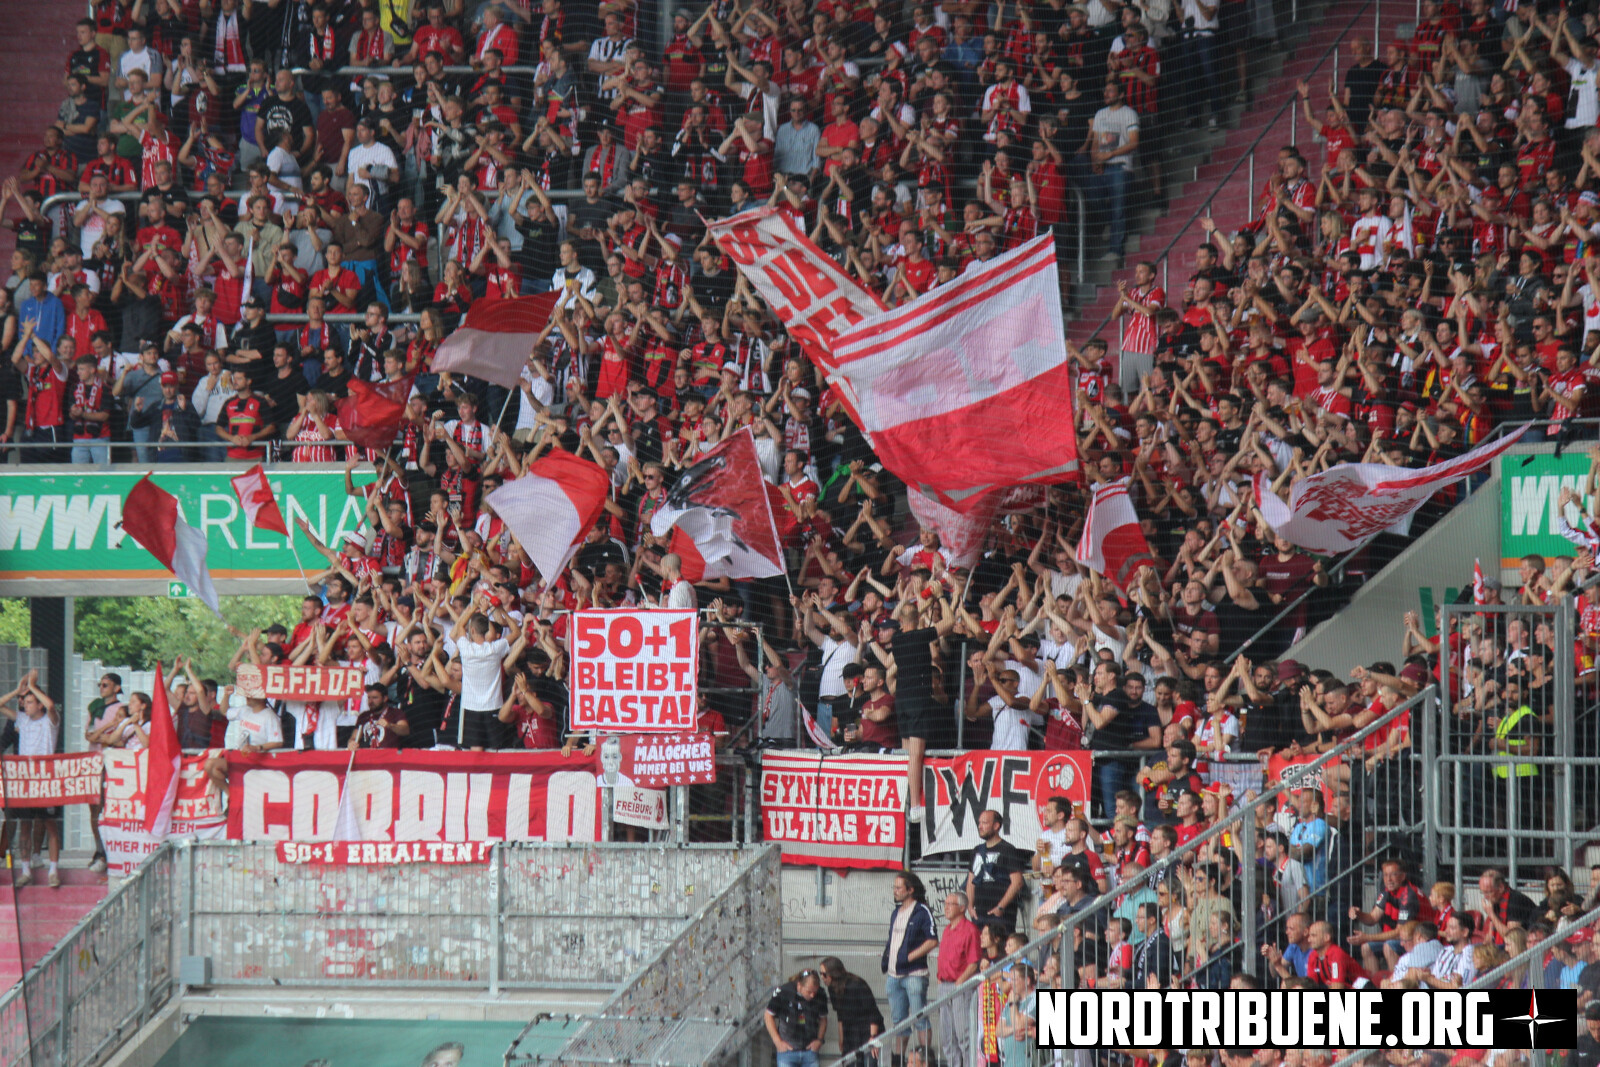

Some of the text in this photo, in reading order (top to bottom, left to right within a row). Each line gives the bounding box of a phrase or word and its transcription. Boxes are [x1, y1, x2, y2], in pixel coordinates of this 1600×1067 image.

[577, 616, 692, 659] 50+1
[266, 666, 362, 696] G.F.H.D.P.
[577, 662, 692, 692] BLEIBT.
[579, 694, 691, 725] BASTA!
[53, 755, 102, 779] MUSS
[633, 759, 713, 775] IMMER BEI UNS
[634, 742, 712, 762] MALOCHER
[64, 775, 101, 796] SEIN
[633, 791, 644, 802] SC
[763, 774, 901, 809] SYNTHESIA
[924, 755, 1031, 844] IWF
[243, 769, 597, 842] CORRILLO
[767, 811, 896, 843] ULTRAS 79
[283, 843, 334, 863] 50+1
